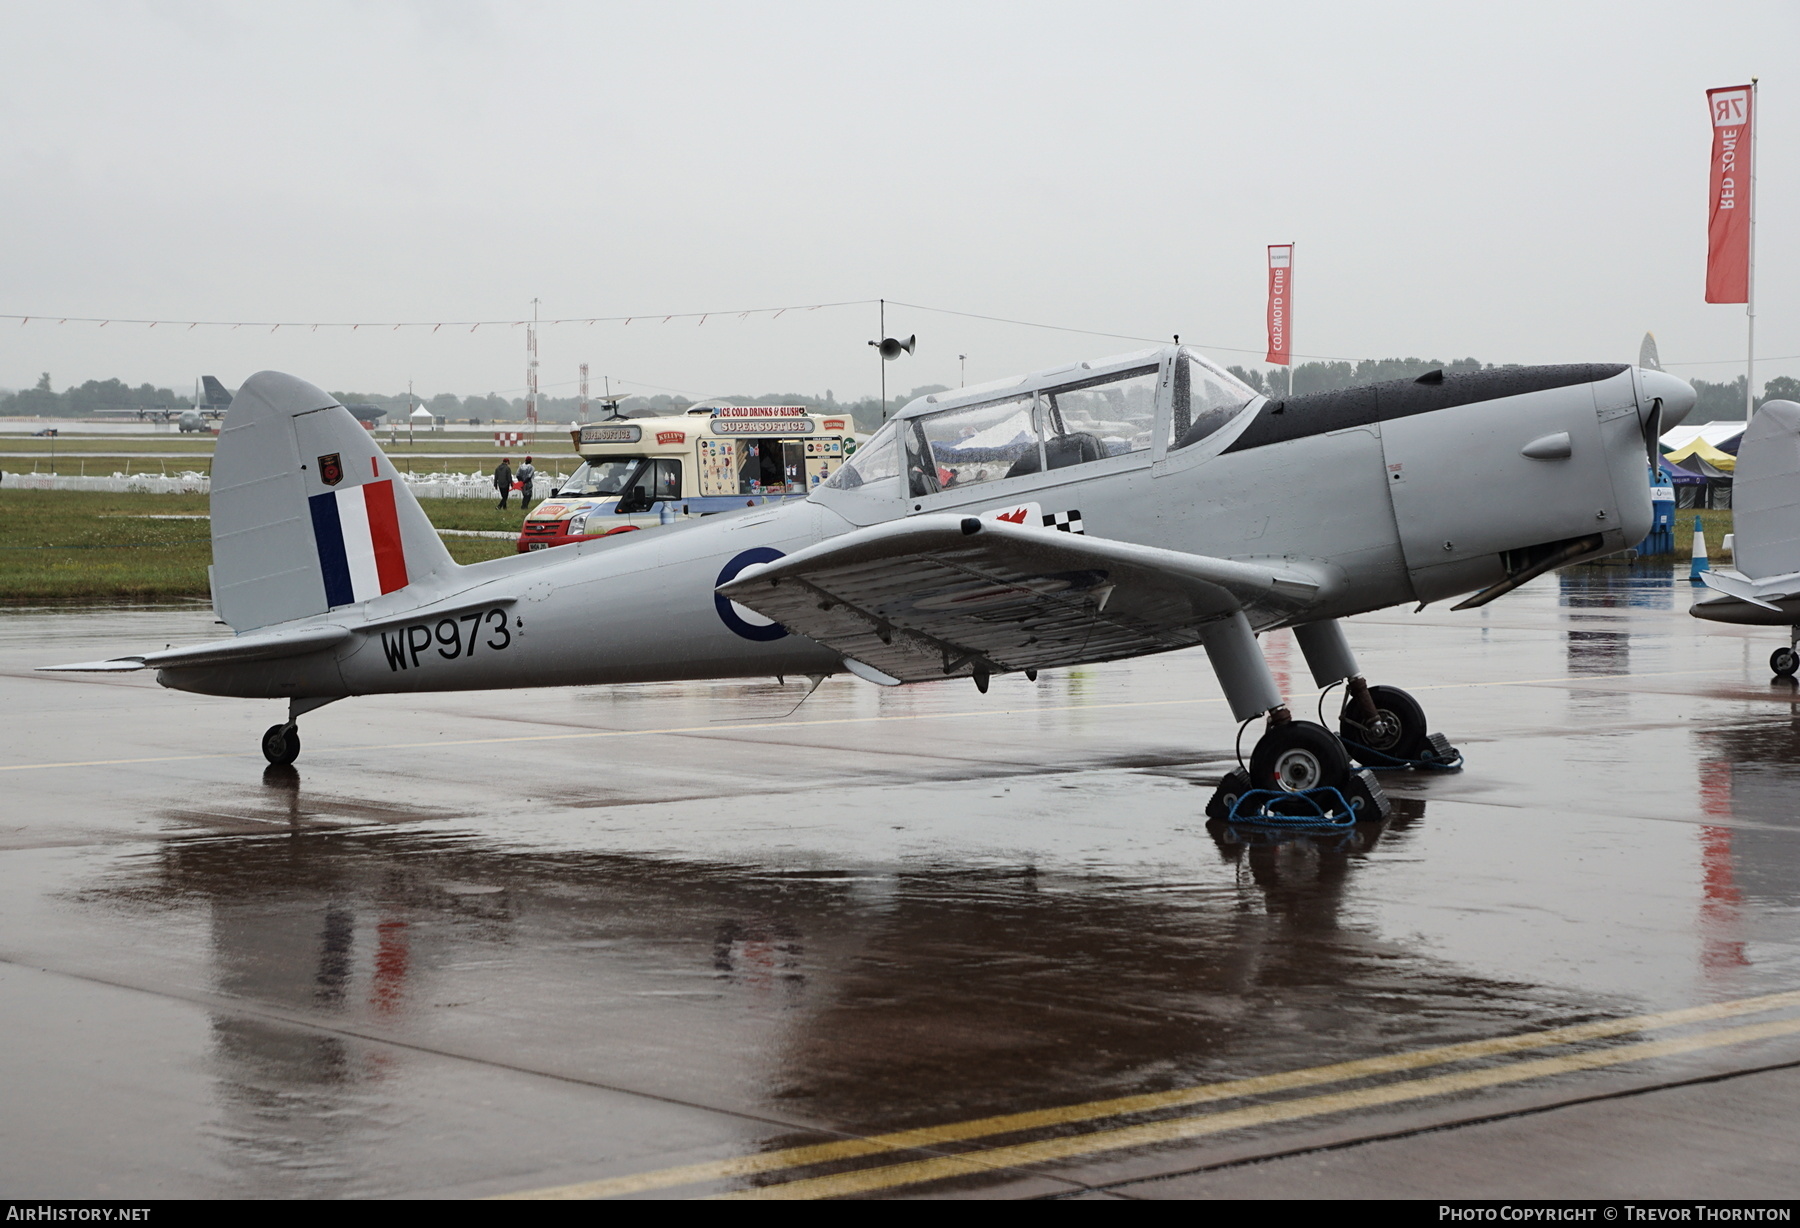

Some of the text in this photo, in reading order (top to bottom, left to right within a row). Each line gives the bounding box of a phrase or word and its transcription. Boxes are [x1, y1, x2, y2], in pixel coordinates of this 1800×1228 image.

[720, 407, 799, 417] ICE COLD DRINKS & SLUSH
[721, 421, 805, 432] SUPER SOFT ICE
[584, 429, 631, 440] SUPER SOFT ICE
[658, 432, 683, 441] KELLY'S
[381, 608, 511, 672] WP973
